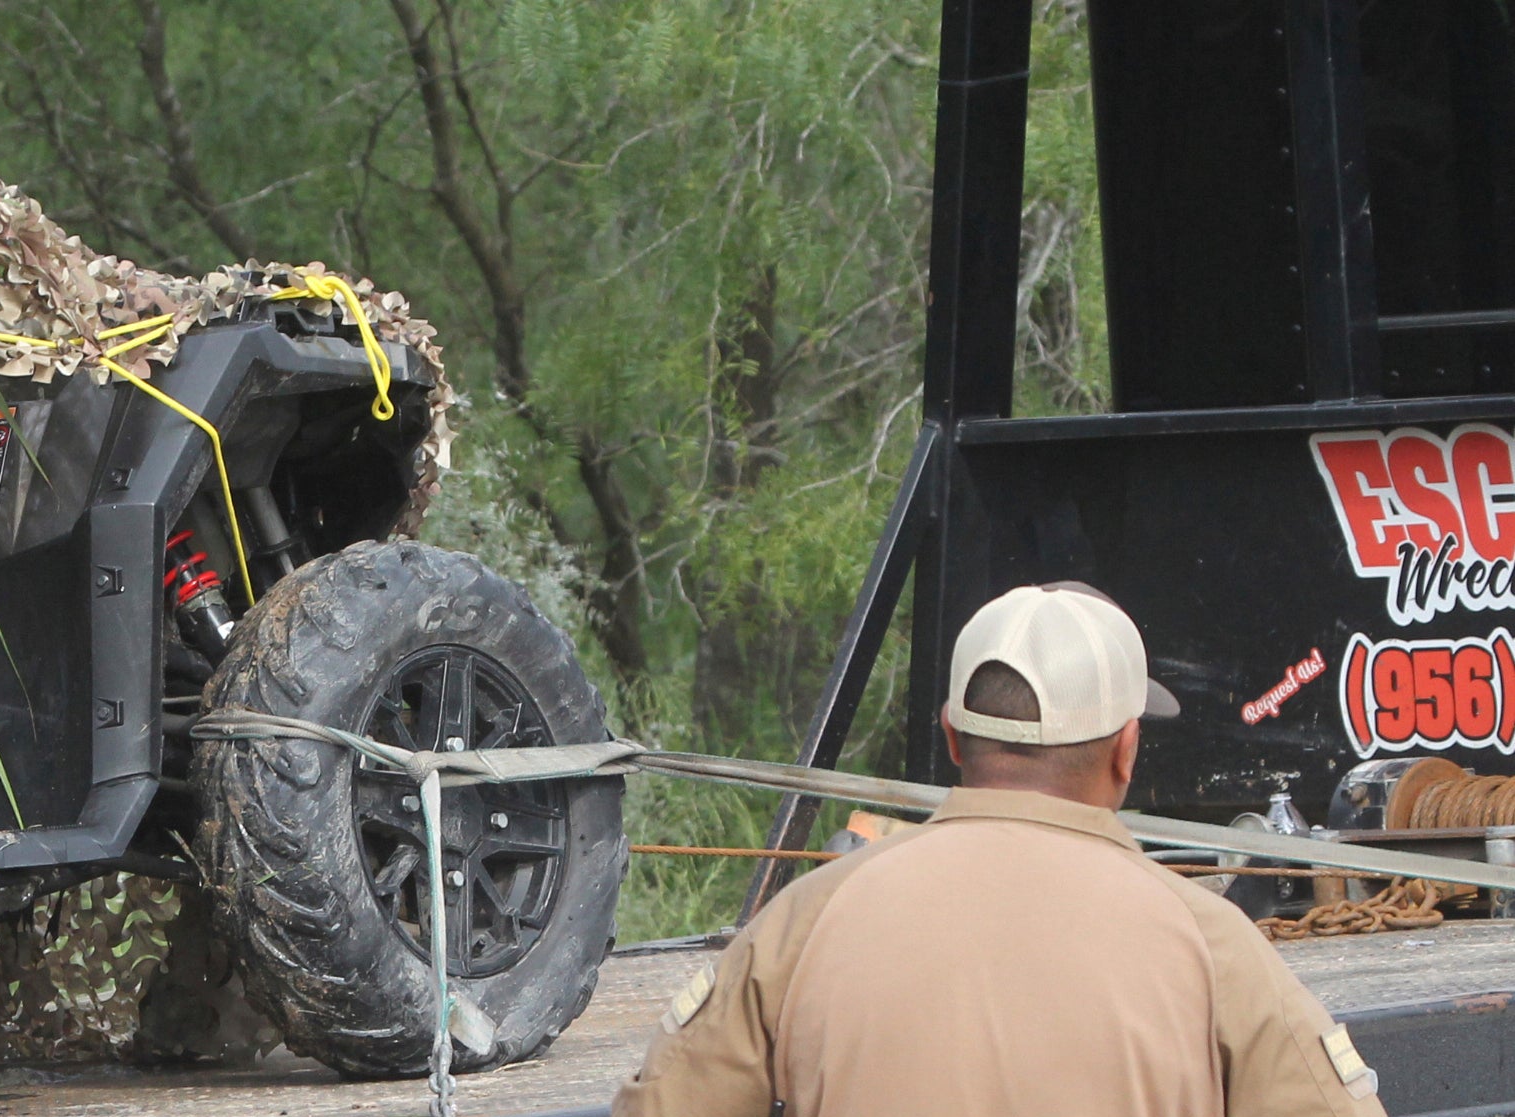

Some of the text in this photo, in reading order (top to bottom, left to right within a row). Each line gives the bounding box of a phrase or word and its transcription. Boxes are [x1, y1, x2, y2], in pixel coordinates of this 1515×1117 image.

[1395, 534, 1515, 614] Wrec
[1244, 669, 1299, 722] Request
[1345, 632, 1515, 750] (956)
